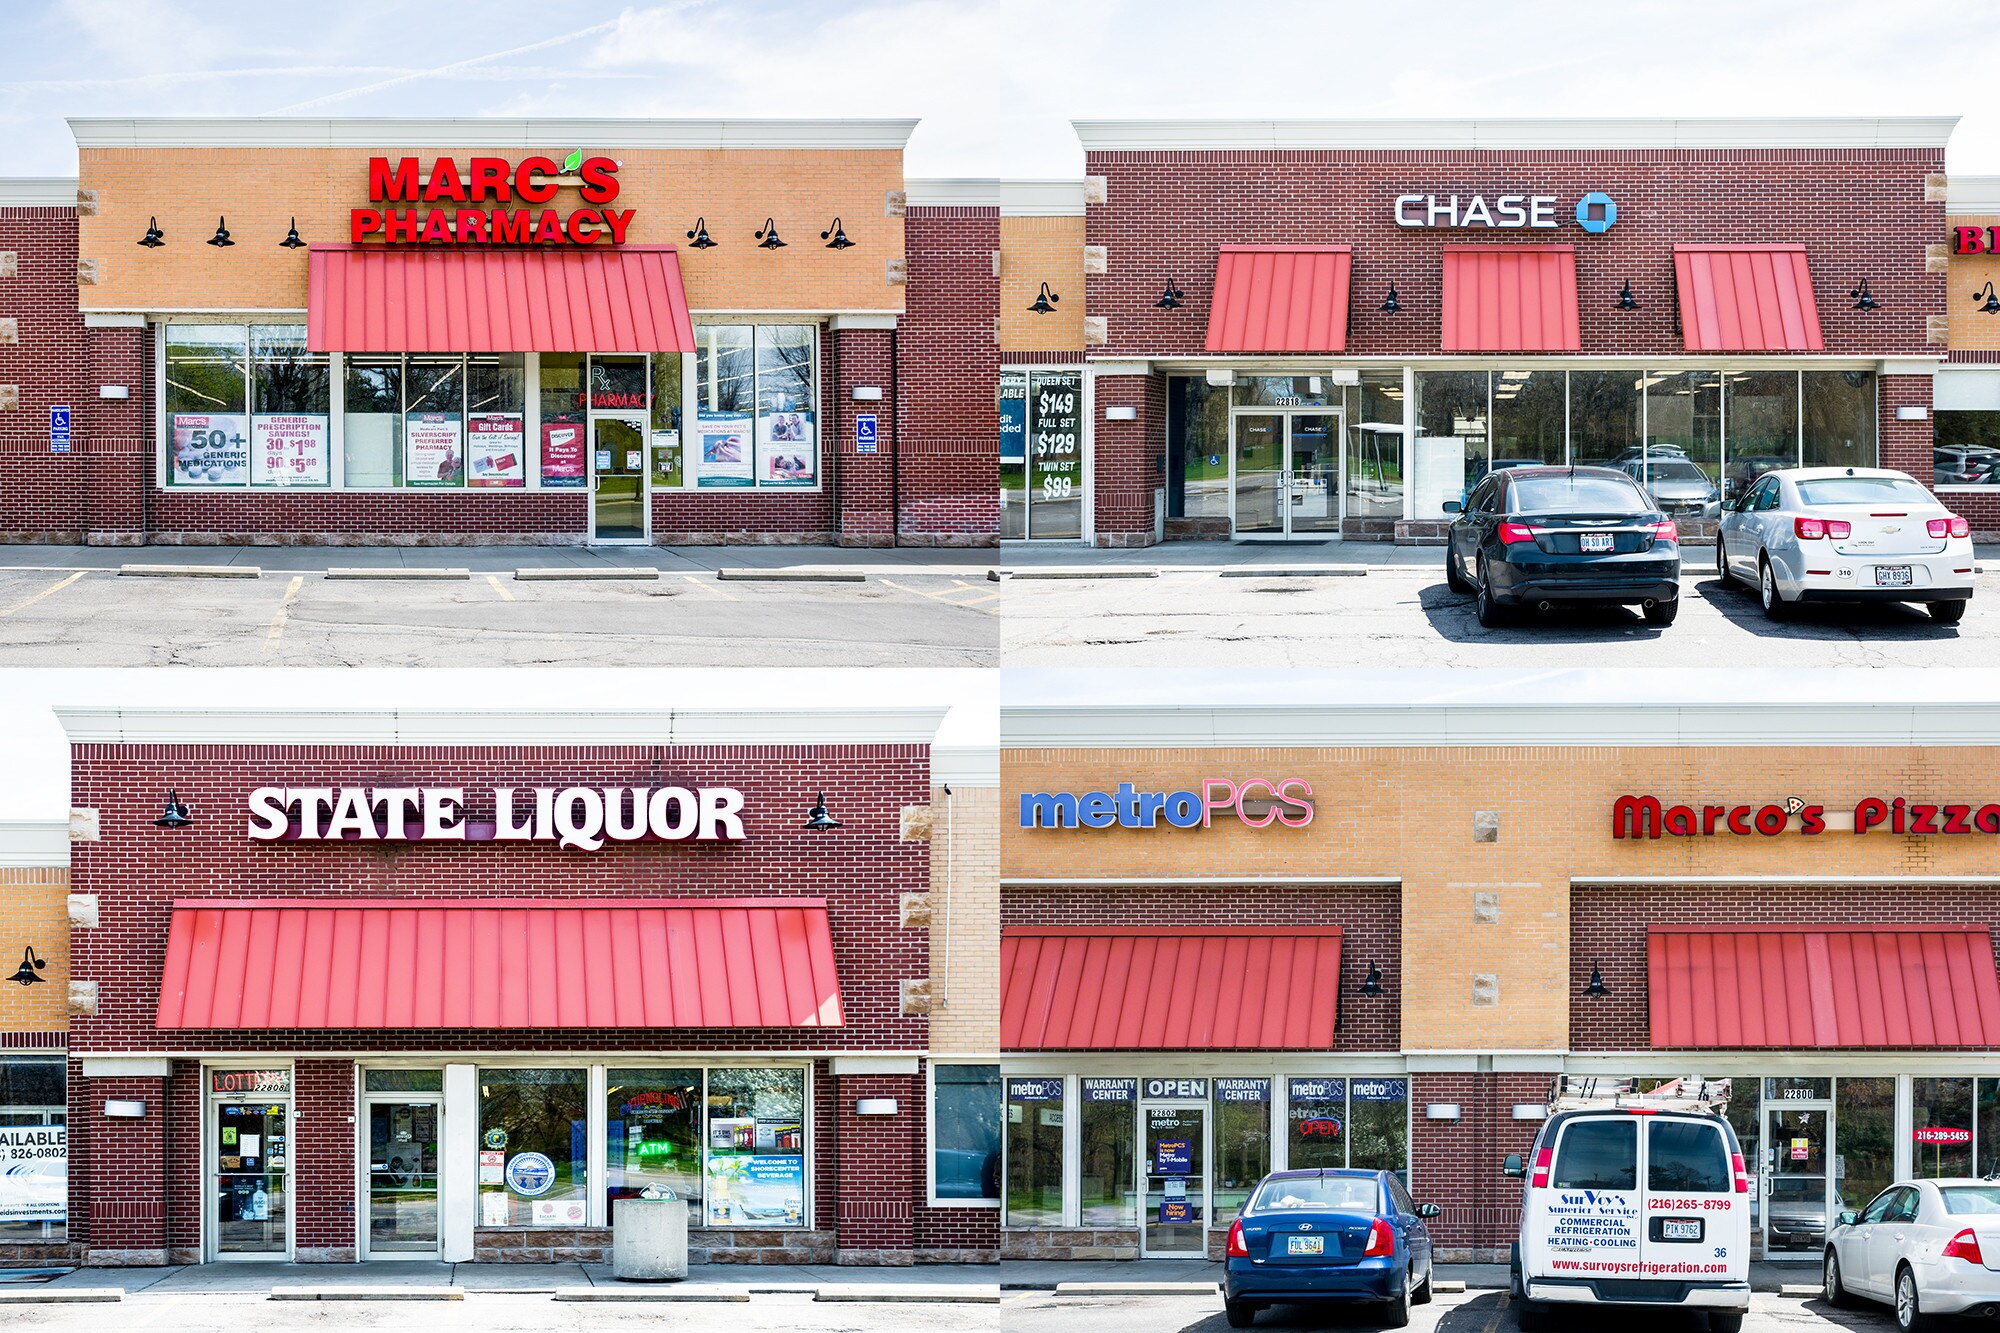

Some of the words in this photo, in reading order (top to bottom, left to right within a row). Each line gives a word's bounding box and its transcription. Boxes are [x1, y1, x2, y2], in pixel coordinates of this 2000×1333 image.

[1394, 194, 1559, 228] CHASE
[350, 208, 637, 244] PHARMACY
[1037, 376, 1061, 388] QUEEN
[1062, 375, 1076, 386] SET
[1039, 390, 1074, 418] $149
[1276, 397, 1300, 406] 22818
[270, 416, 308, 424] GENERIC
[1038, 418, 1057, 428] FULL
[1059, 417, 1076, 428] SET
[257, 423, 321, 431] PRESCRIPTION
[478, 423, 492, 431] Gift
[493, 423, 514, 431] Cards
[268, 430, 310, 438] SAVINGS!
[551, 431, 574, 439] DISCOVER
[266, 438, 284, 450] 30
[1037, 430, 1076, 458] $129
[178, 459, 246, 467] MEDICATIONS
[1038, 461, 1059, 472] TWIN
[1059, 461, 1076, 472] SET
[1042, 474, 1072, 501] $99
[1581, 537, 1590, 547] OH
[1878, 571, 1892, 580] GHX
[1892, 571, 1910, 580] 8936
[1019, 777, 1315, 829] metroPCS
[247, 786, 466, 841] STATE
[493, 786, 748, 852] LIQUOR
[1612, 794, 1826, 840] Marco's
[1854, 796, 2000, 835] Pizza
[254, 1084, 285, 1092] 22808
[1011, 1080, 1062, 1095] metroPCS
[1085, 1079, 1136, 1090] WARRANTY
[1148, 1080, 1205, 1096] OPEN
[1217, 1079, 1269, 1090] WARRANTY
[1292, 1081, 1345, 1096] metroPCS
[1353, 1081, 1405, 1096] metroPCS
[1092, 1089, 1128, 1100] CENTER
[1224, 1090, 1261, 1100] CENTER
[1785, 1089, 1814, 1099] 22800
[627, 1091, 681, 1111] YUENGLING
[1152, 1109, 1176, 1117] 22802
[1289, 1106, 1345, 1119] etroPCS
[1151, 1118, 1180, 1127] metro
[1300, 1120, 1340, 1135] OPEN
[1917, 1131, 1969, 1140] 216-289-5455
[11, 1147, 67, 1159] 826-0802
[640, 1142, 669, 1156] ATM
[1548, 1205, 1592, 1214] Superior
[1599, 1207, 1638, 1215] Service
[1647, 1198, 1731, 1211] (216)265-8799
[1165, 1209, 1186, 1217] hiring!
[1560, 1218, 1625, 1227] COMMERCIAL
[1554, 1226, 1631, 1236] REFRIGERATION
[1665, 1224, 1679, 1234] PIK
[1680, 1225, 1698, 1235] 9762
[1290, 1240, 1303, 1250] FUL
[1304, 1240, 1321, 1250] 9641
[1714, 1247, 1727, 1258] 36
[1552, 1260, 1728, 1276] www.survoysrefrigeration.com
